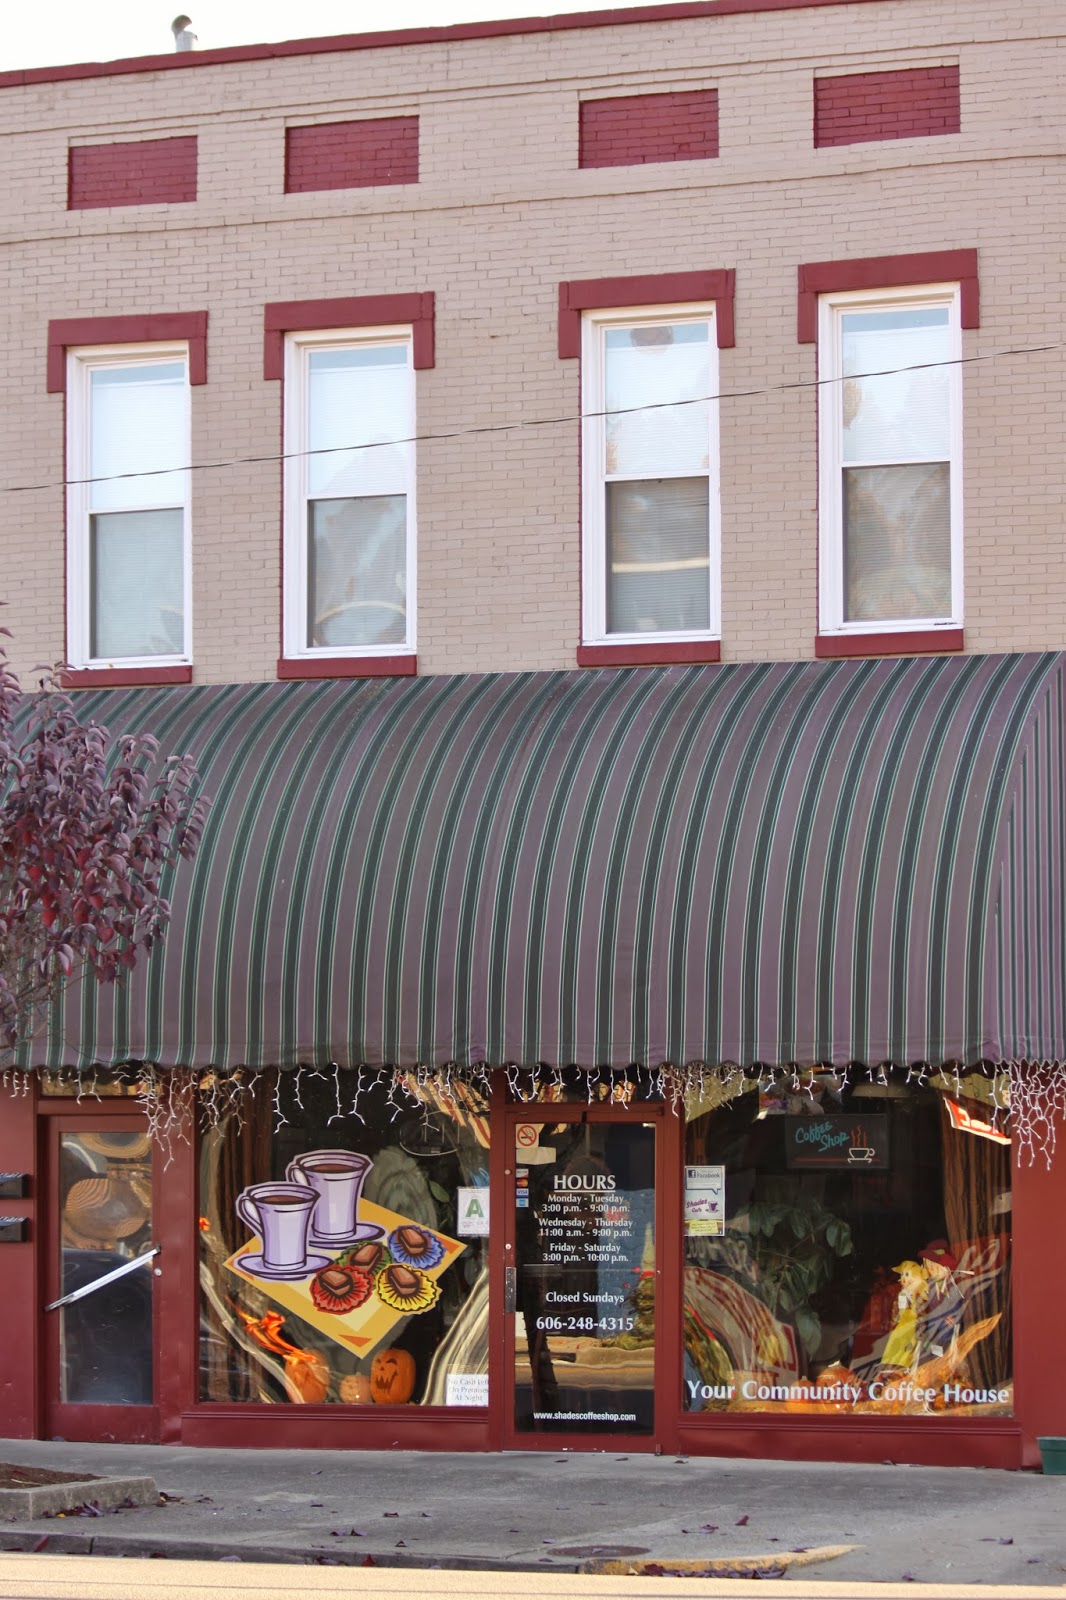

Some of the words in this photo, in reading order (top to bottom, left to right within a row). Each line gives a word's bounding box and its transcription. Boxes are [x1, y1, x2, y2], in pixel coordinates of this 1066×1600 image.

[795, 1121, 832, 1143] Coffee
[818, 1132, 850, 1152] Shop
[554, 1175, 616, 1190] HOURS
[547, 1194, 582, 1204] Monday
[589, 1194, 624, 1204] Tuesday
[465, 1199, 484, 1217] A
[563, 1206, 582, 1214] p.m.
[611, 1206, 630, 1214] p.m.
[538, 1218, 587, 1227] Wednesday
[595, 1218, 633, 1228] Thursday
[540, 1229, 563, 1237] 11:00
[593, 1229, 611, 1237] 9:00
[613, 1230, 632, 1239] p.m.
[550, 1243, 576, 1253] Friday
[584, 1243, 621, 1253] Saturday
[611, 1255, 629, 1263] p.m.
[545, 1292, 580, 1302] Closed
[582, 1292, 625, 1305] Sundays
[536, 1316, 634, 1330] 606-248-4315
[465, 1394, 483, 1403] Night
[687, 1380, 736, 1399] Your
[742, 1380, 862, 1406] Community
[868, 1381, 936, 1402] Coffee
[944, 1383, 1010, 1403] House
[533, 1411, 636, 1422] www.shadescoffeeshop.com
